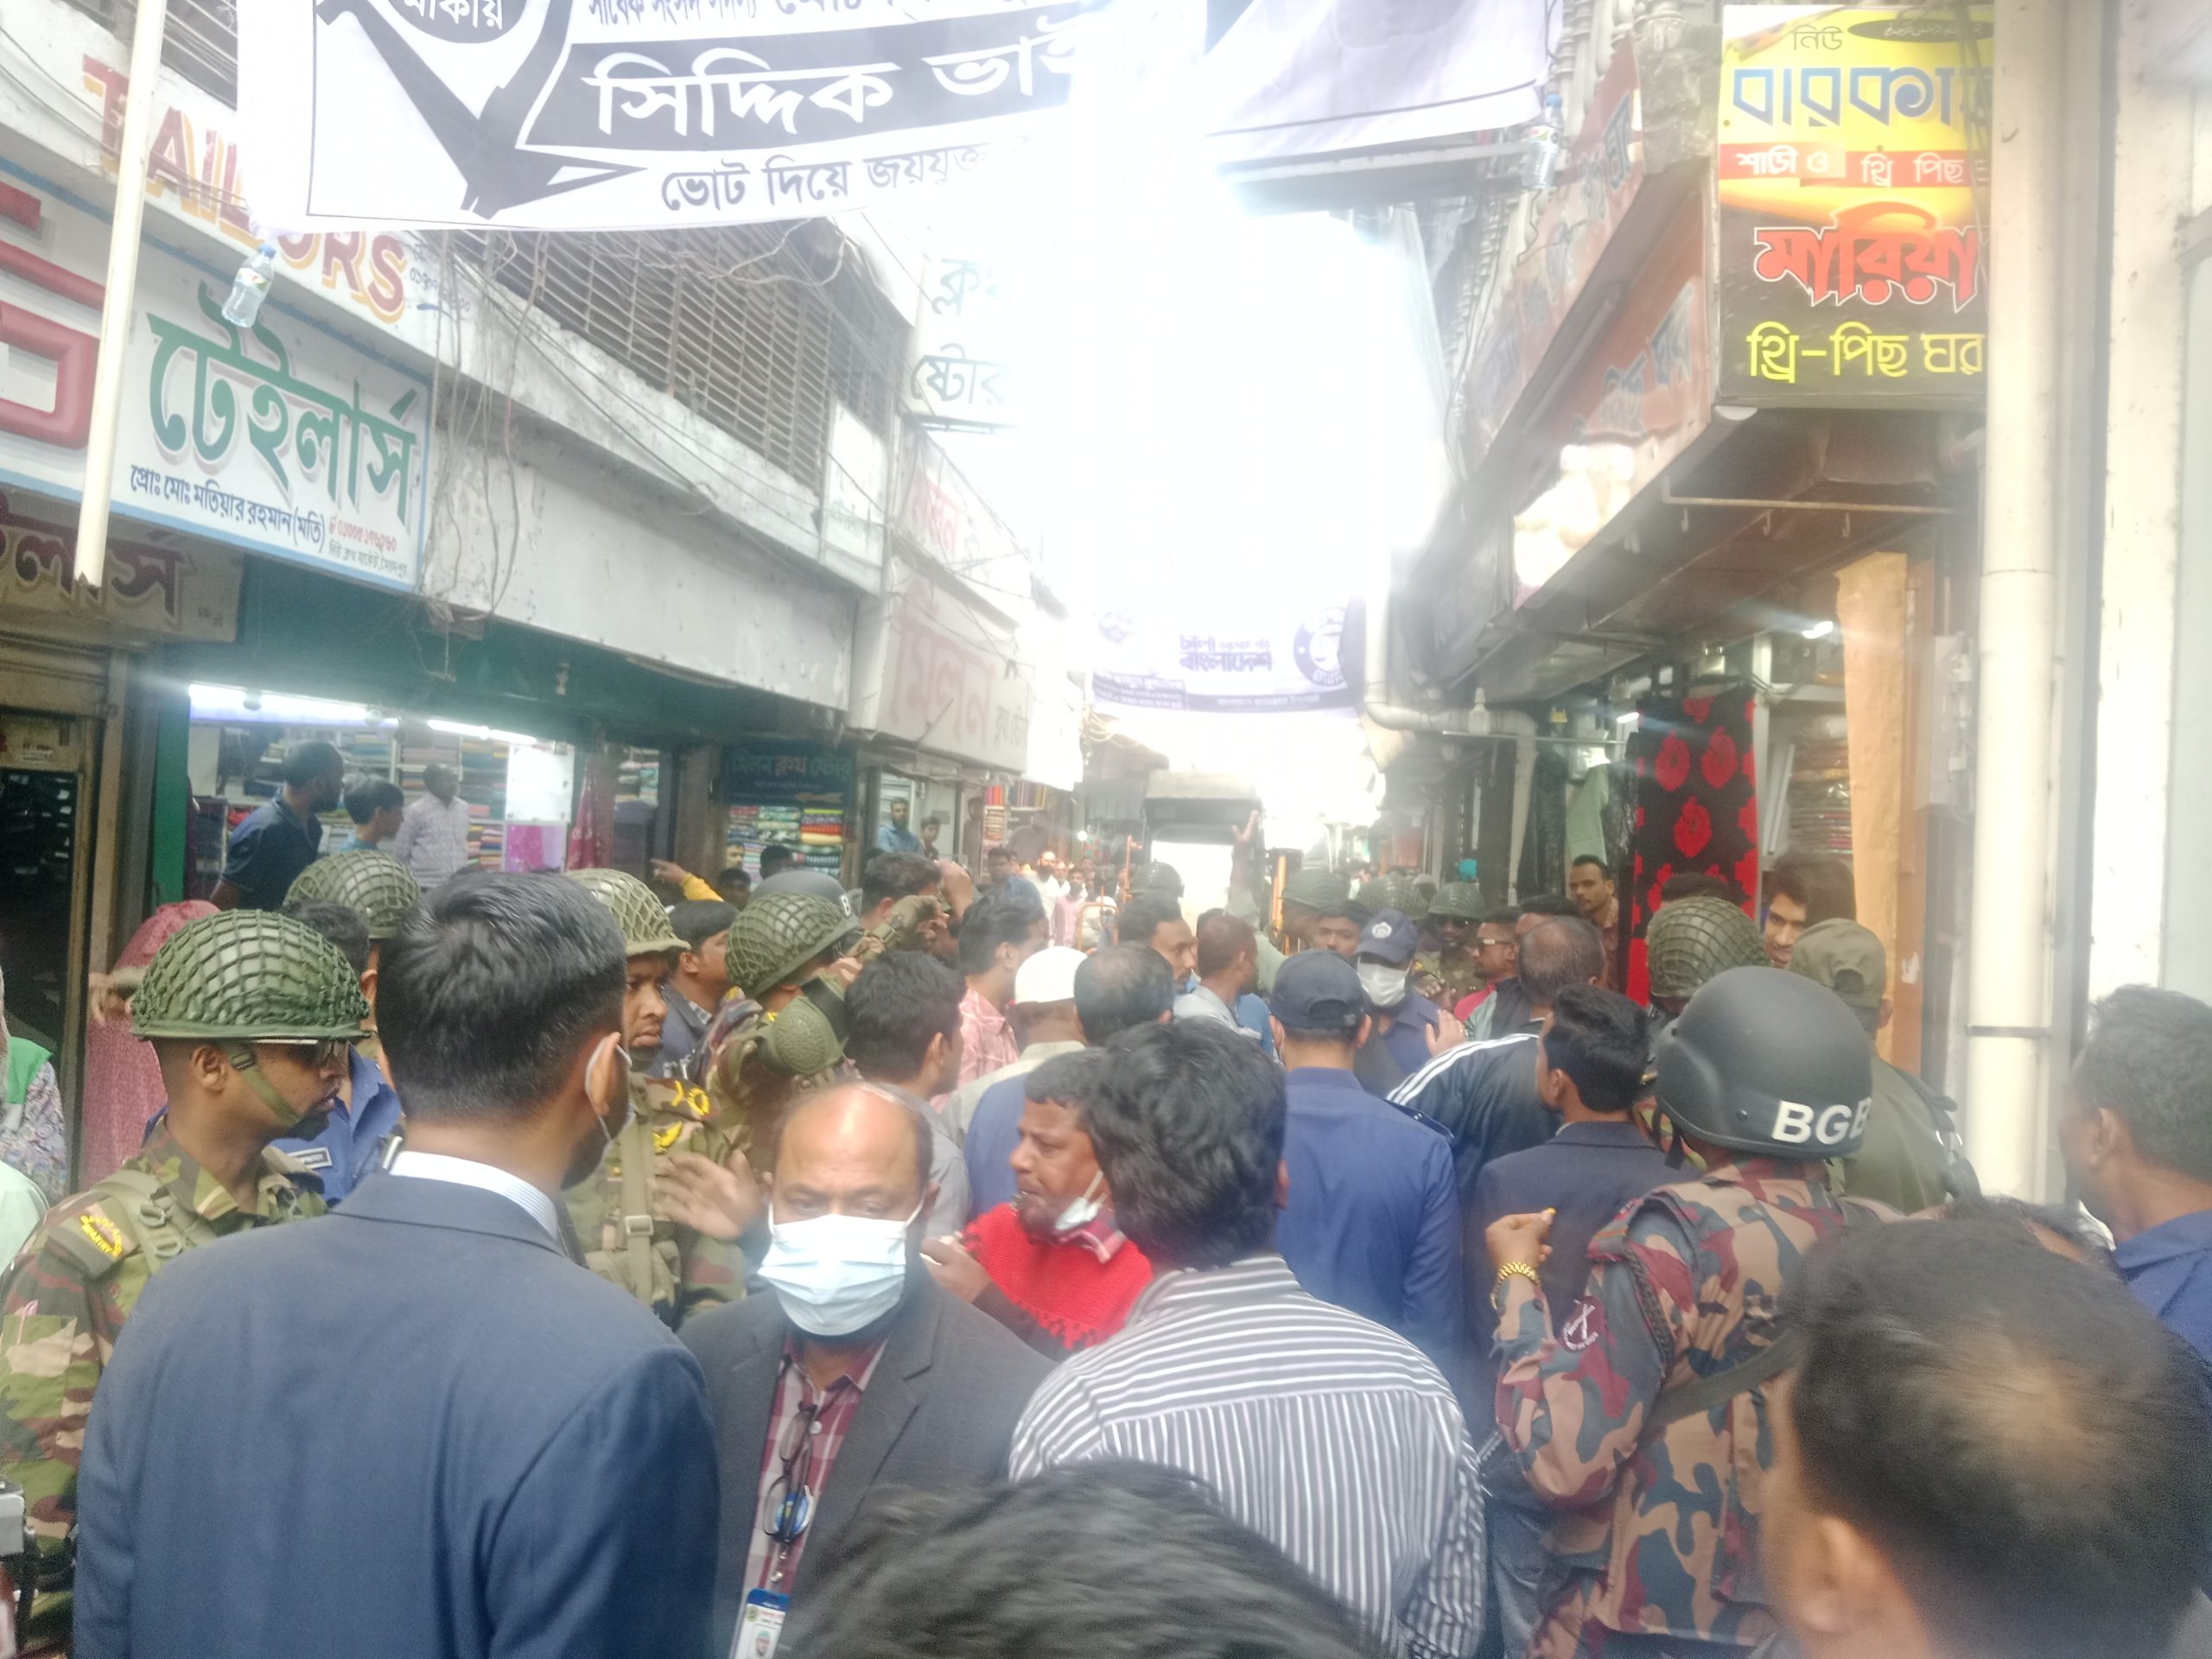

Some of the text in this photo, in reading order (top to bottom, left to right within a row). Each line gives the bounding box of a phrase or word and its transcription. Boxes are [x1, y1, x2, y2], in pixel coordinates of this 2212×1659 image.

[1793, 24, 1844, 51] নিউ
[581, 48, 902, 137] সিদ্দিক
[661, 156, 751, 212] ভোট
[761, 155, 852, 207] দিয়ে
[1808, 150, 1830, 174] ও
[1860, 152, 1893, 188] থ্রি
[1914, 151, 1965, 185] পিছ
[145, 279, 417, 522] টেইলার্স
[163, 476, 191, 505] মোঃ
[194, 479, 245, 522] মতিয়ার
[247, 500, 293, 537] রহমান
[1178, 650, 1273, 672] বাংলাদেশ
[1770, 1096, 1873, 1146] BGB
